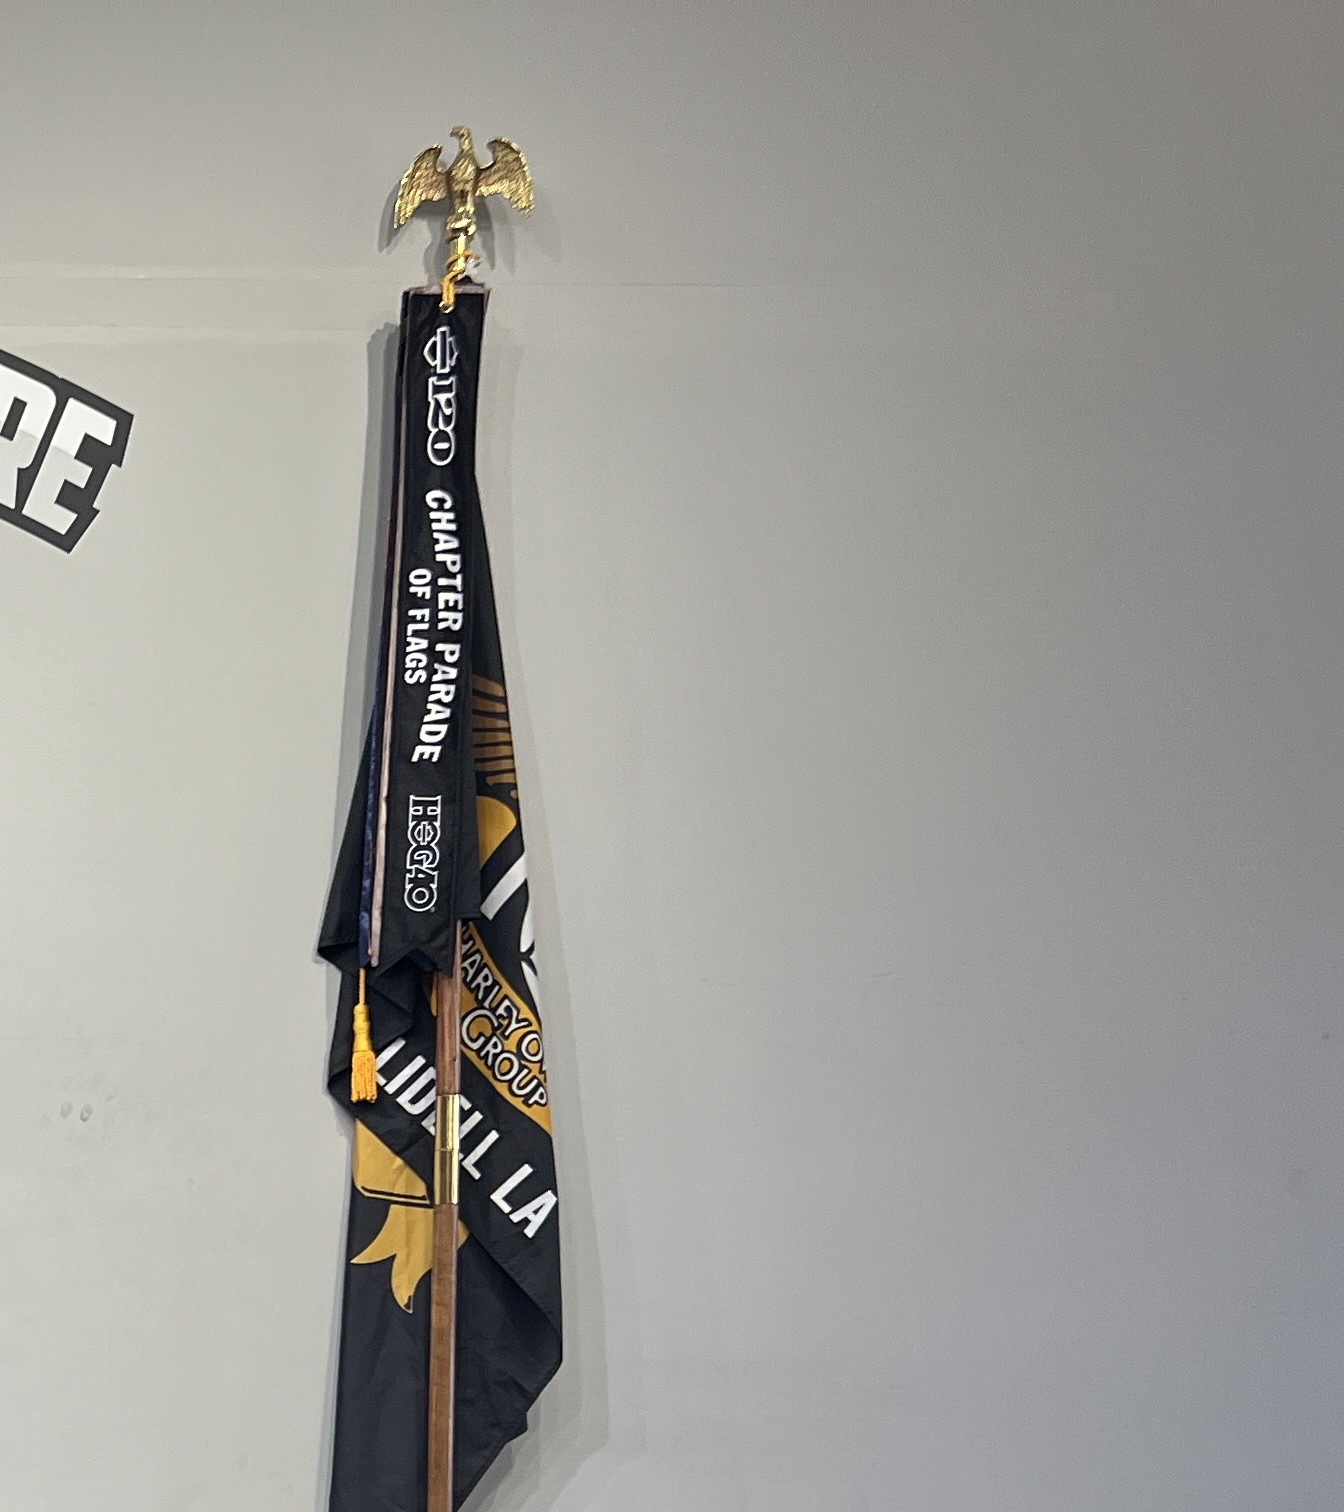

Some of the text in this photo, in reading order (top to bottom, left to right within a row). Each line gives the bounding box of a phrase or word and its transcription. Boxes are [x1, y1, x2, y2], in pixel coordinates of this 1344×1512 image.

[404, 568, 432, 684] OF FLAGS
[411, 489, 465, 763] CHAPTER PARADE
[461, 1008, 548, 1106] GROUP
[489, 1163, 558, 1239] LA
